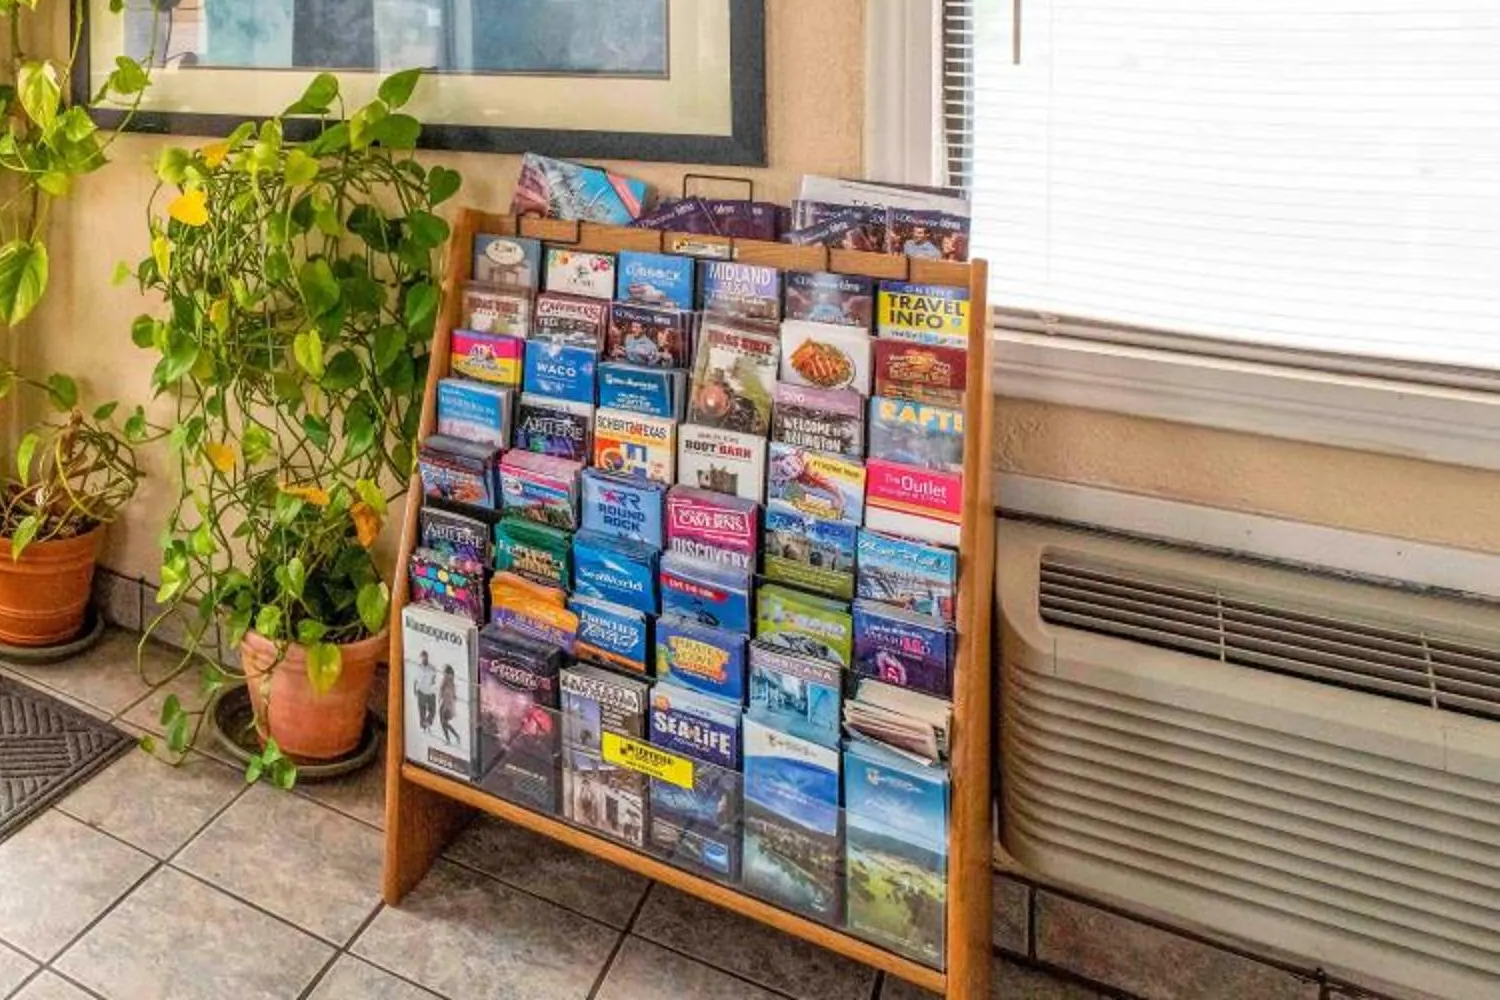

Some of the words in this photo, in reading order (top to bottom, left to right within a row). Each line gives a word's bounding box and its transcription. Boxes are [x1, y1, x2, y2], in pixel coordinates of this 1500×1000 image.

[709, 263, 771, 286] MIDLAND
[888, 293, 965, 317] TRAVEL
[889, 310, 944, 329] INFO
[536, 363, 577, 377] WACO
[522, 415, 584, 441] ABILENE
[783, 416, 829, 437] WELCOME
[684, 440, 717, 453] BOOT
[719, 444, 752, 458] BARN
[884, 473, 900, 485] The
[901, 475, 947, 498] Outlet
[598, 503, 646, 522] ROUND
[604, 515, 641, 532] ROCK
[425, 521, 485, 548] ABILENE
[672, 536, 750, 569] DISCOVERY
[580, 567, 644, 592] SeaWorld
